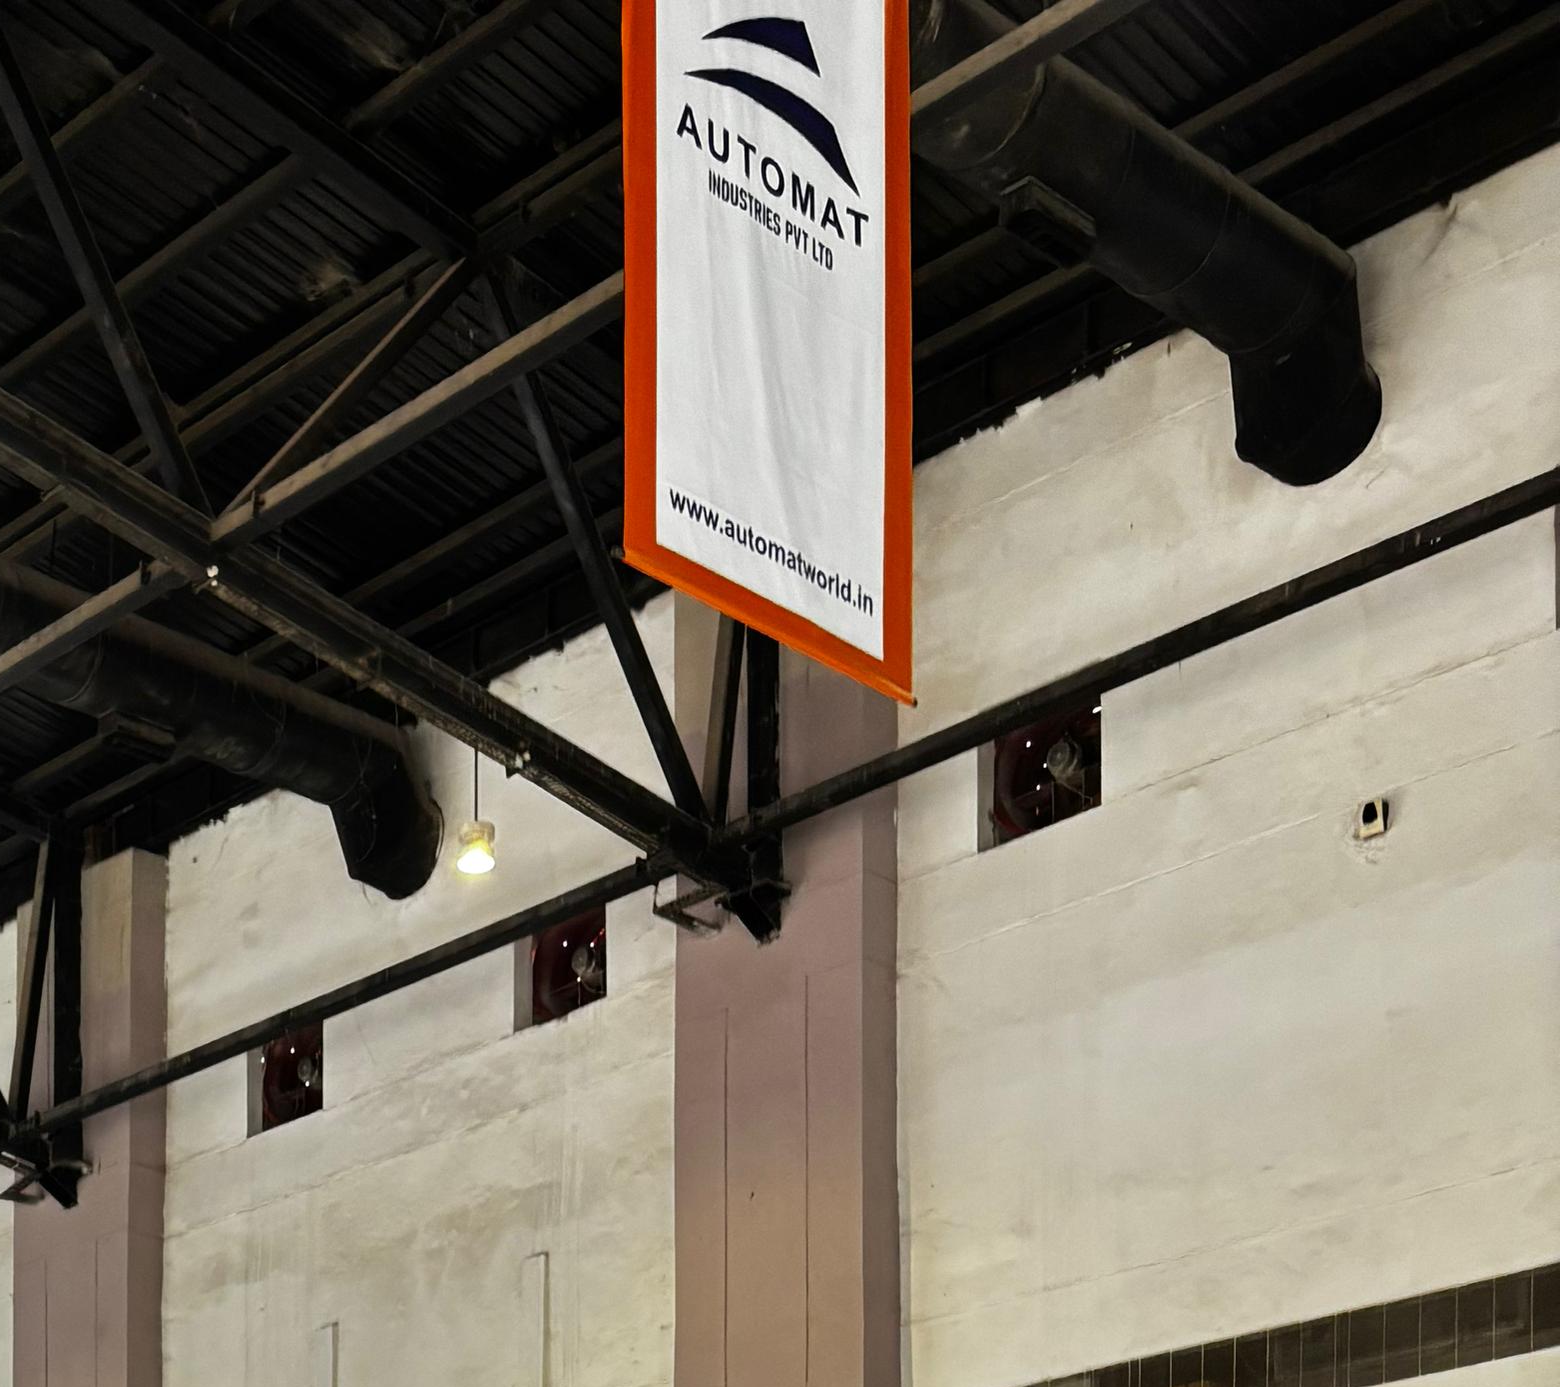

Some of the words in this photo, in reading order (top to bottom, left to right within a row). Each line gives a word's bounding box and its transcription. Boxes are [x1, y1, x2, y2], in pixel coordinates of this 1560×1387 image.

[676, 102, 869, 248] AUTOMAT
[708, 167, 781, 237] INDUSTRIES
[785, 208, 809, 255] PVT
[812, 239, 834, 271] LTD
[669, 488, 873, 618] www.automatworld.in
